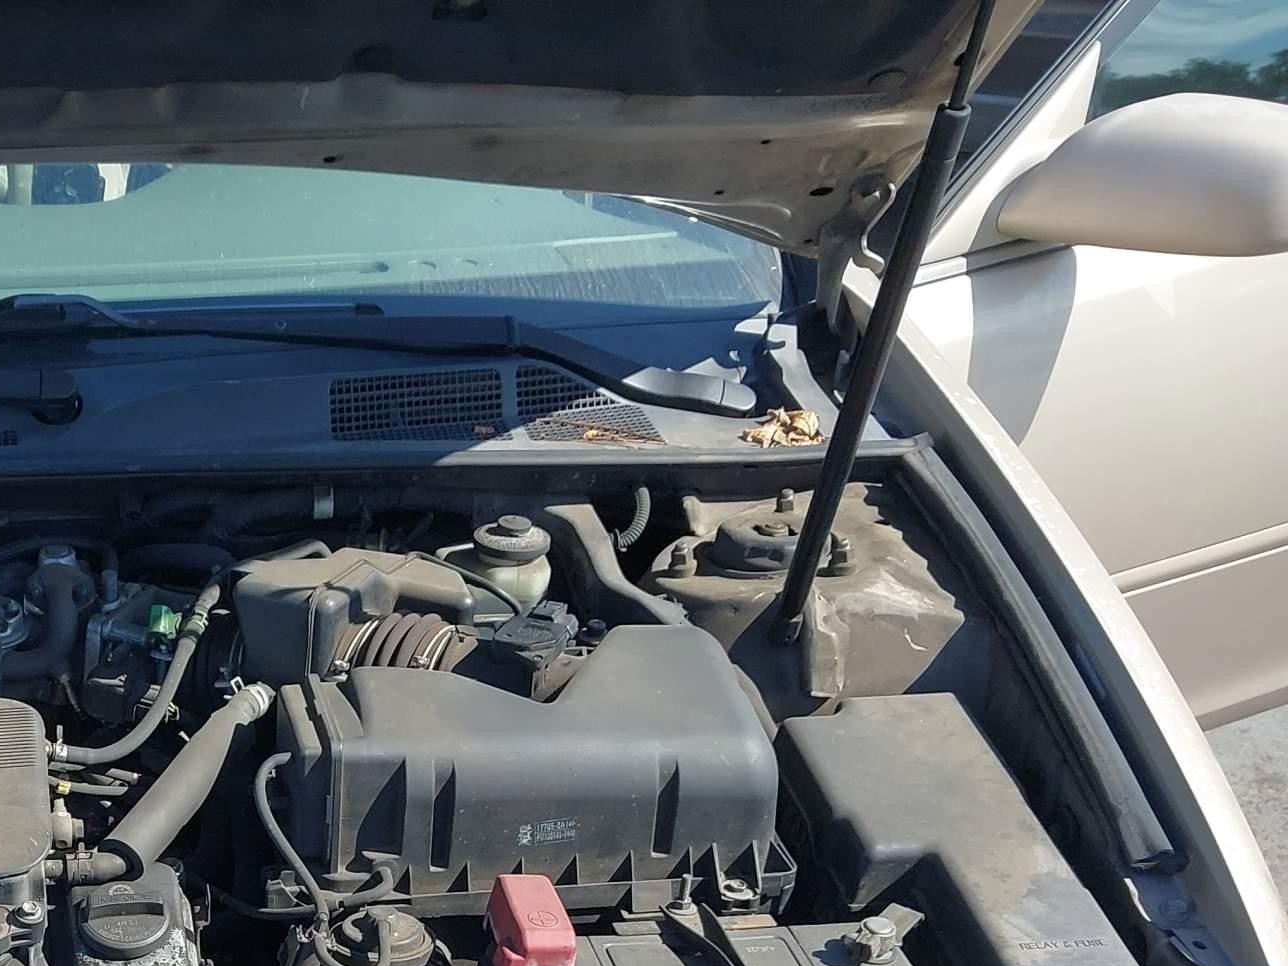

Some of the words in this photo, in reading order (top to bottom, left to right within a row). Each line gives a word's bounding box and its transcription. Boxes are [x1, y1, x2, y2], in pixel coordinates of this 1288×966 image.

[1019, 941, 1059, 950] RELAY
[1062, 940, 1072, 949] &
[1074, 939, 1108, 949] FUSE
